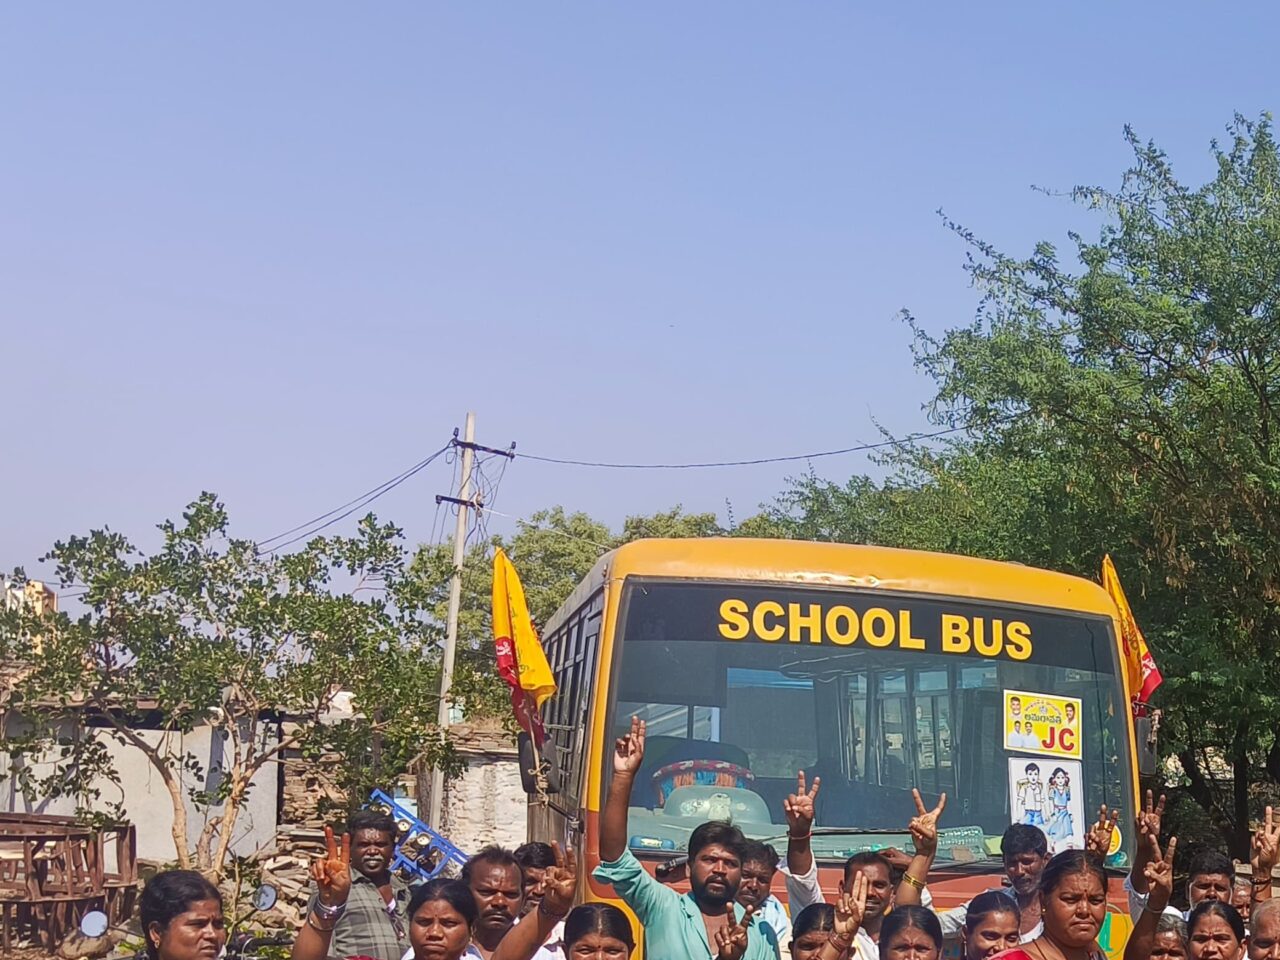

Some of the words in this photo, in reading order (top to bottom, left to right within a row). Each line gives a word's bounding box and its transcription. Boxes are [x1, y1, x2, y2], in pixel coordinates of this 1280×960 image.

[718, 599, 926, 650] SCHOOL
[942, 614, 1032, 661] BUS
[1041, 726, 1075, 751] JC
